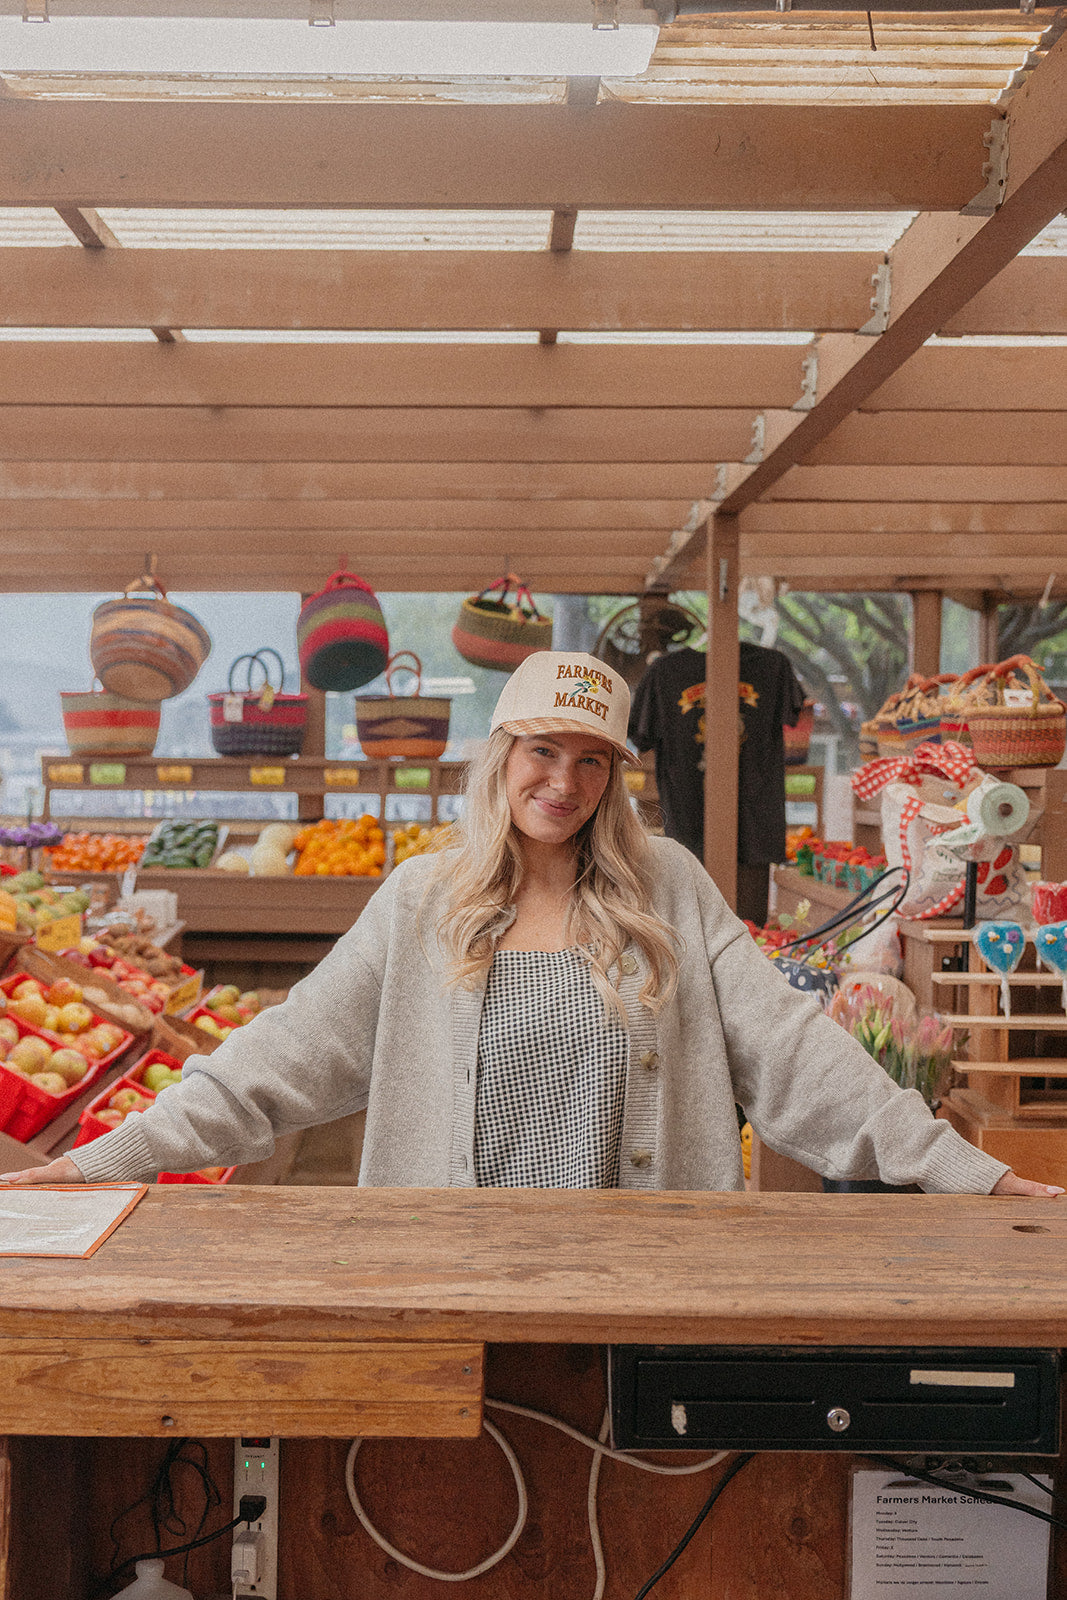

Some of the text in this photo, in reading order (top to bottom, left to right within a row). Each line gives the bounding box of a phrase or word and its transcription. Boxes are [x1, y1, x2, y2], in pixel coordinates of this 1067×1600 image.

[556, 665, 613, 694] FARMERS
[553, 692, 609, 721] MARKET
[876, 1495, 919, 1504] Farmers
[921, 1495, 957, 1504] Market
